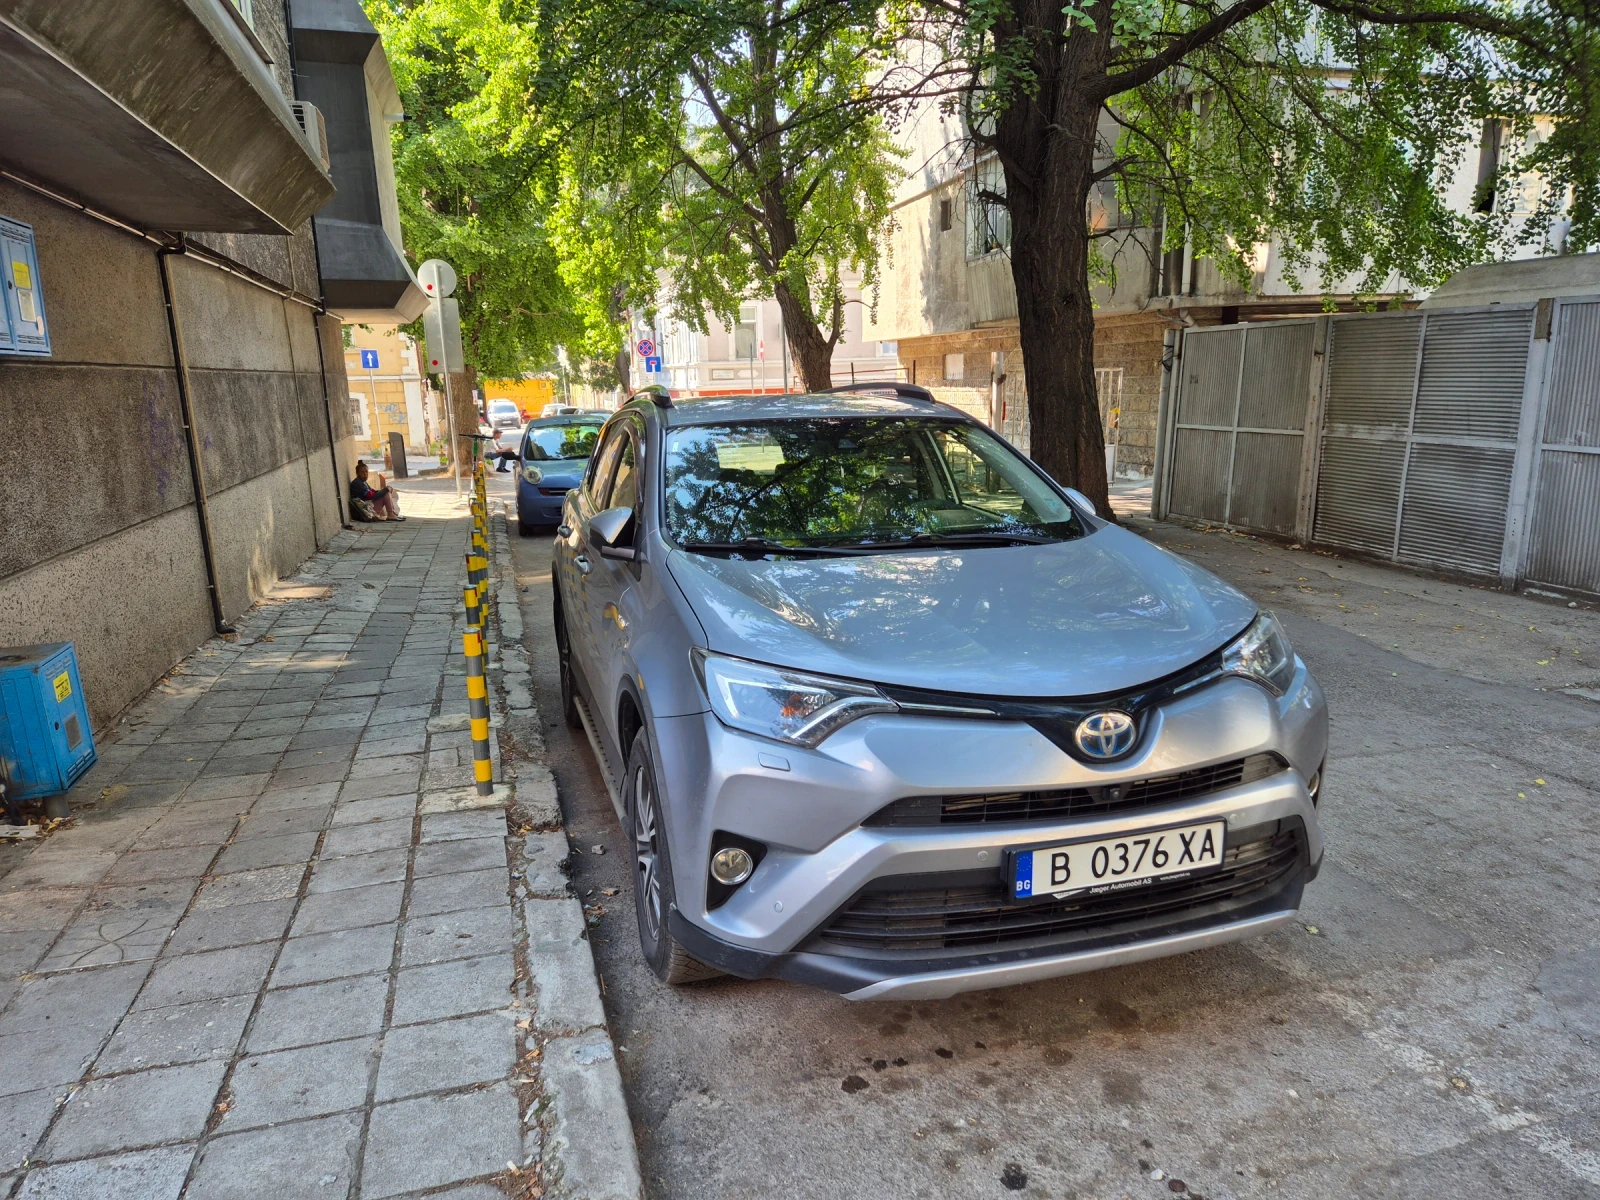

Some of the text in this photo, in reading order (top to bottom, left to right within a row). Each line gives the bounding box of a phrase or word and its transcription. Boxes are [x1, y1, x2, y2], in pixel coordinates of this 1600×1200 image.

[1051, 828, 1216, 886] B 0376 XA
[1016, 879, 1031, 892] BG
[1110, 879, 1142, 890] Automobil
[1142, 877, 1152, 885] AS
